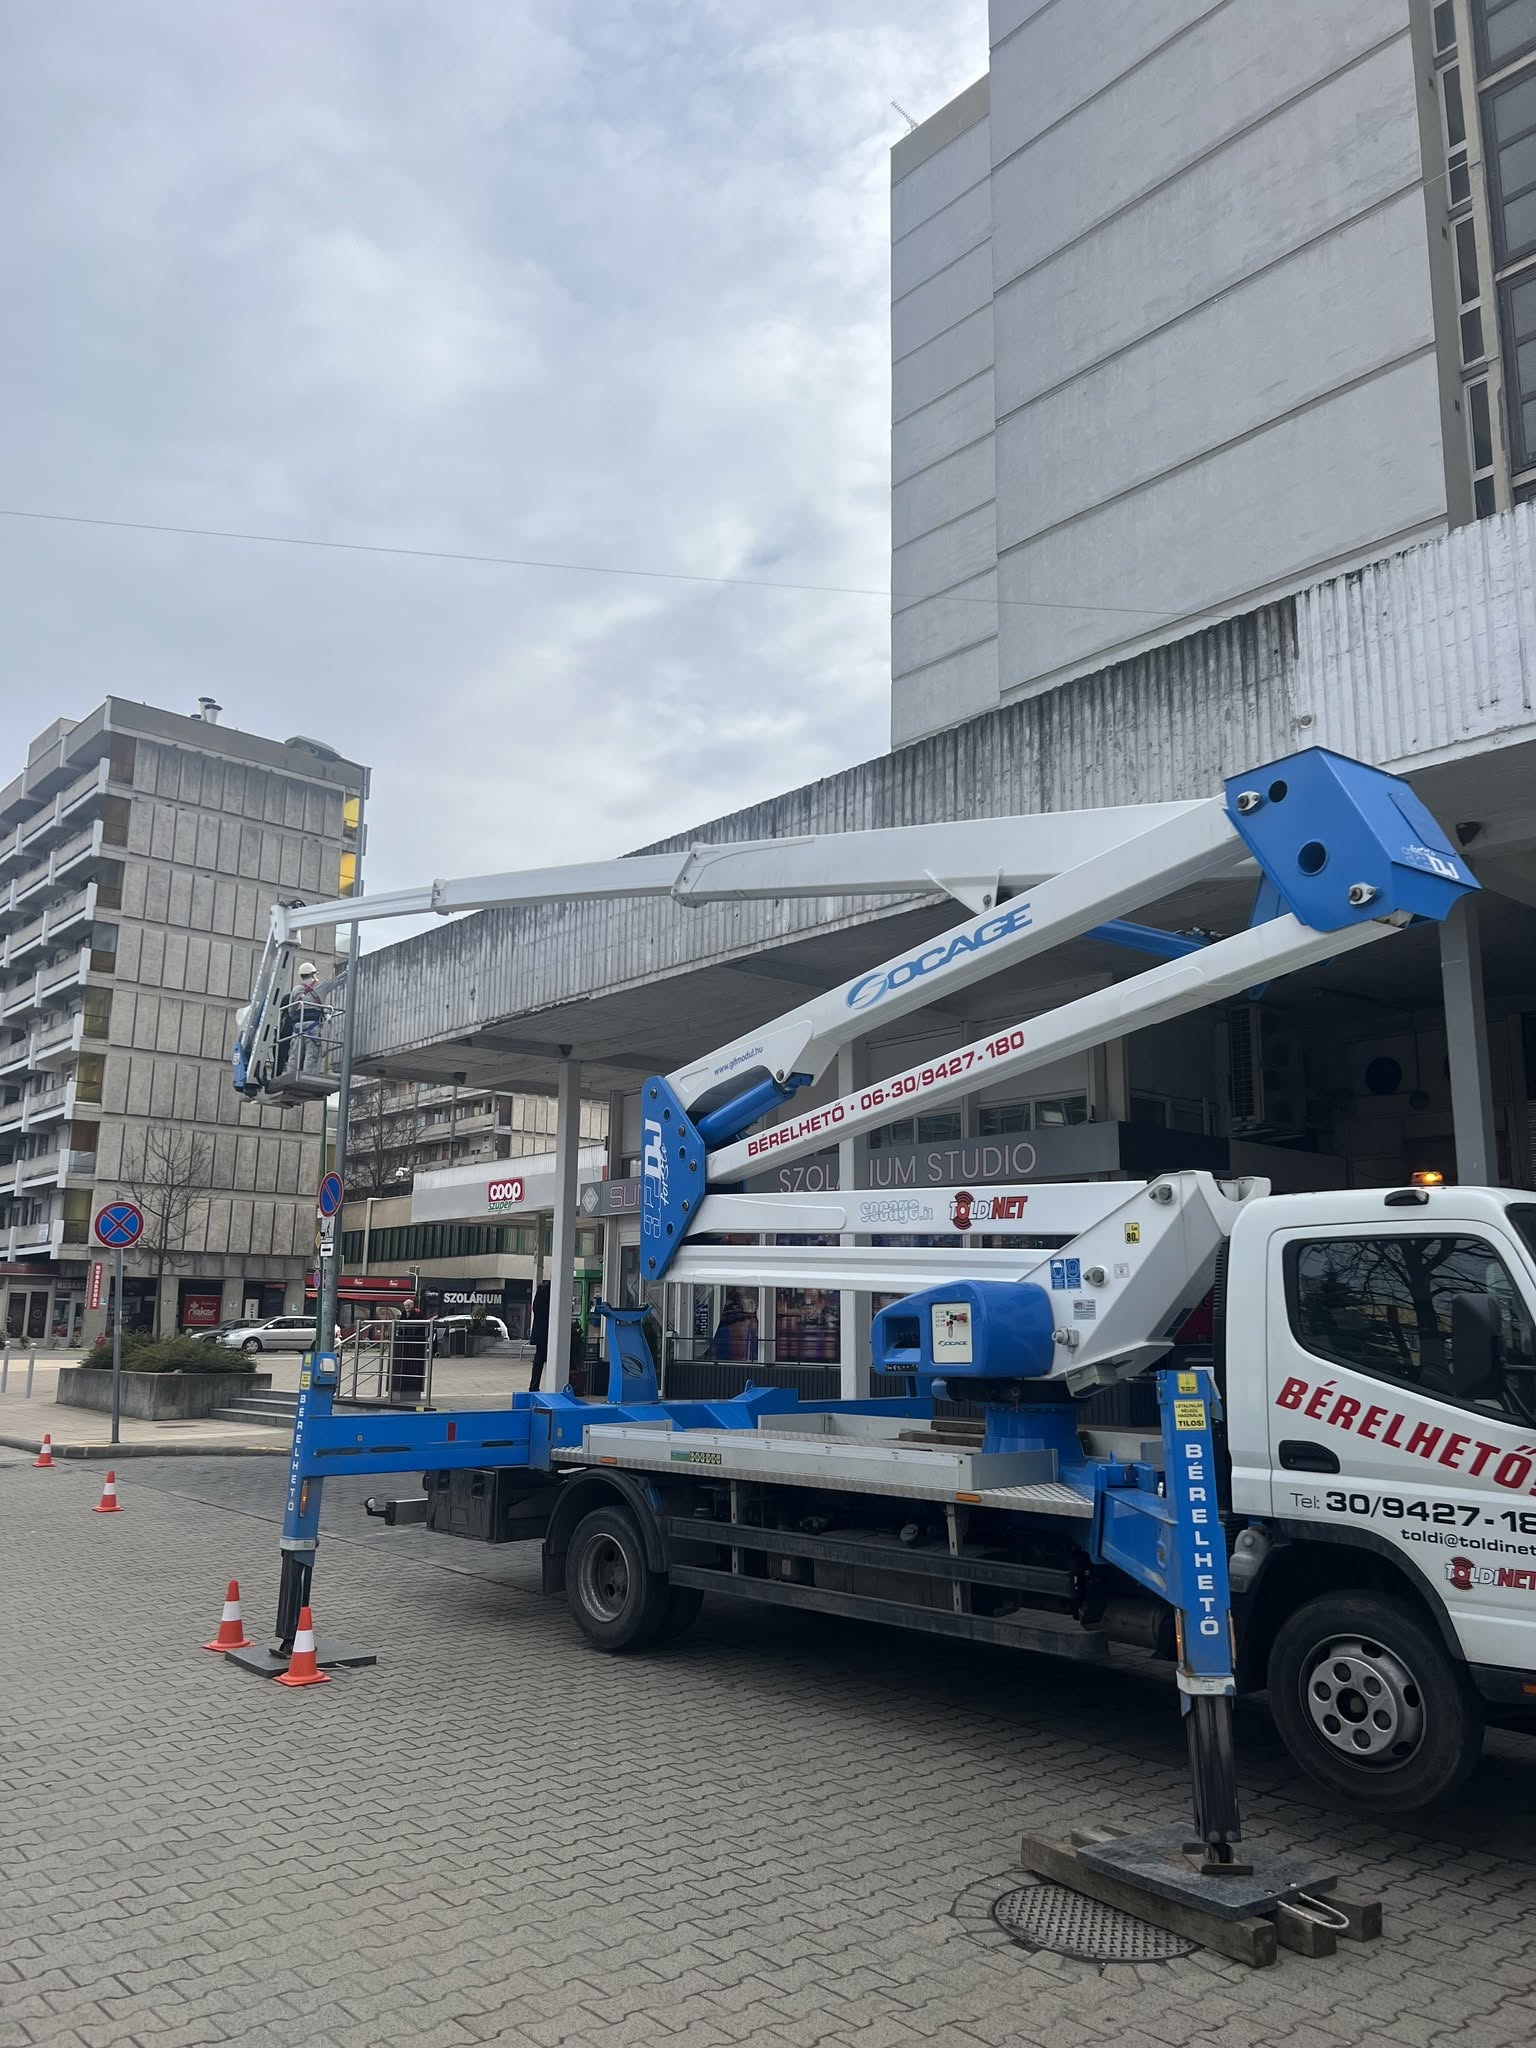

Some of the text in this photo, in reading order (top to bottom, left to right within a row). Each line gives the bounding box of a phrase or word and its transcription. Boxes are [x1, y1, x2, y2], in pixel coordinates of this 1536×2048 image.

[748, 1030, 1025, 1156] BÉRELHETŐ 06-30/9427-180
[927, 1142, 1037, 1182] STUDIO
[490, 1181, 521, 1202] coop
[950, 1192, 1028, 1230] TOLDINET
[443, 1291, 502, 1305] SZOLÁRIUM
[1275, 1377, 1536, 1497] BÉRELHETŐ
[1290, 1493, 1320, 1510] Tel:
[1185, 1444, 1220, 1636] BÉRELHETŐ
